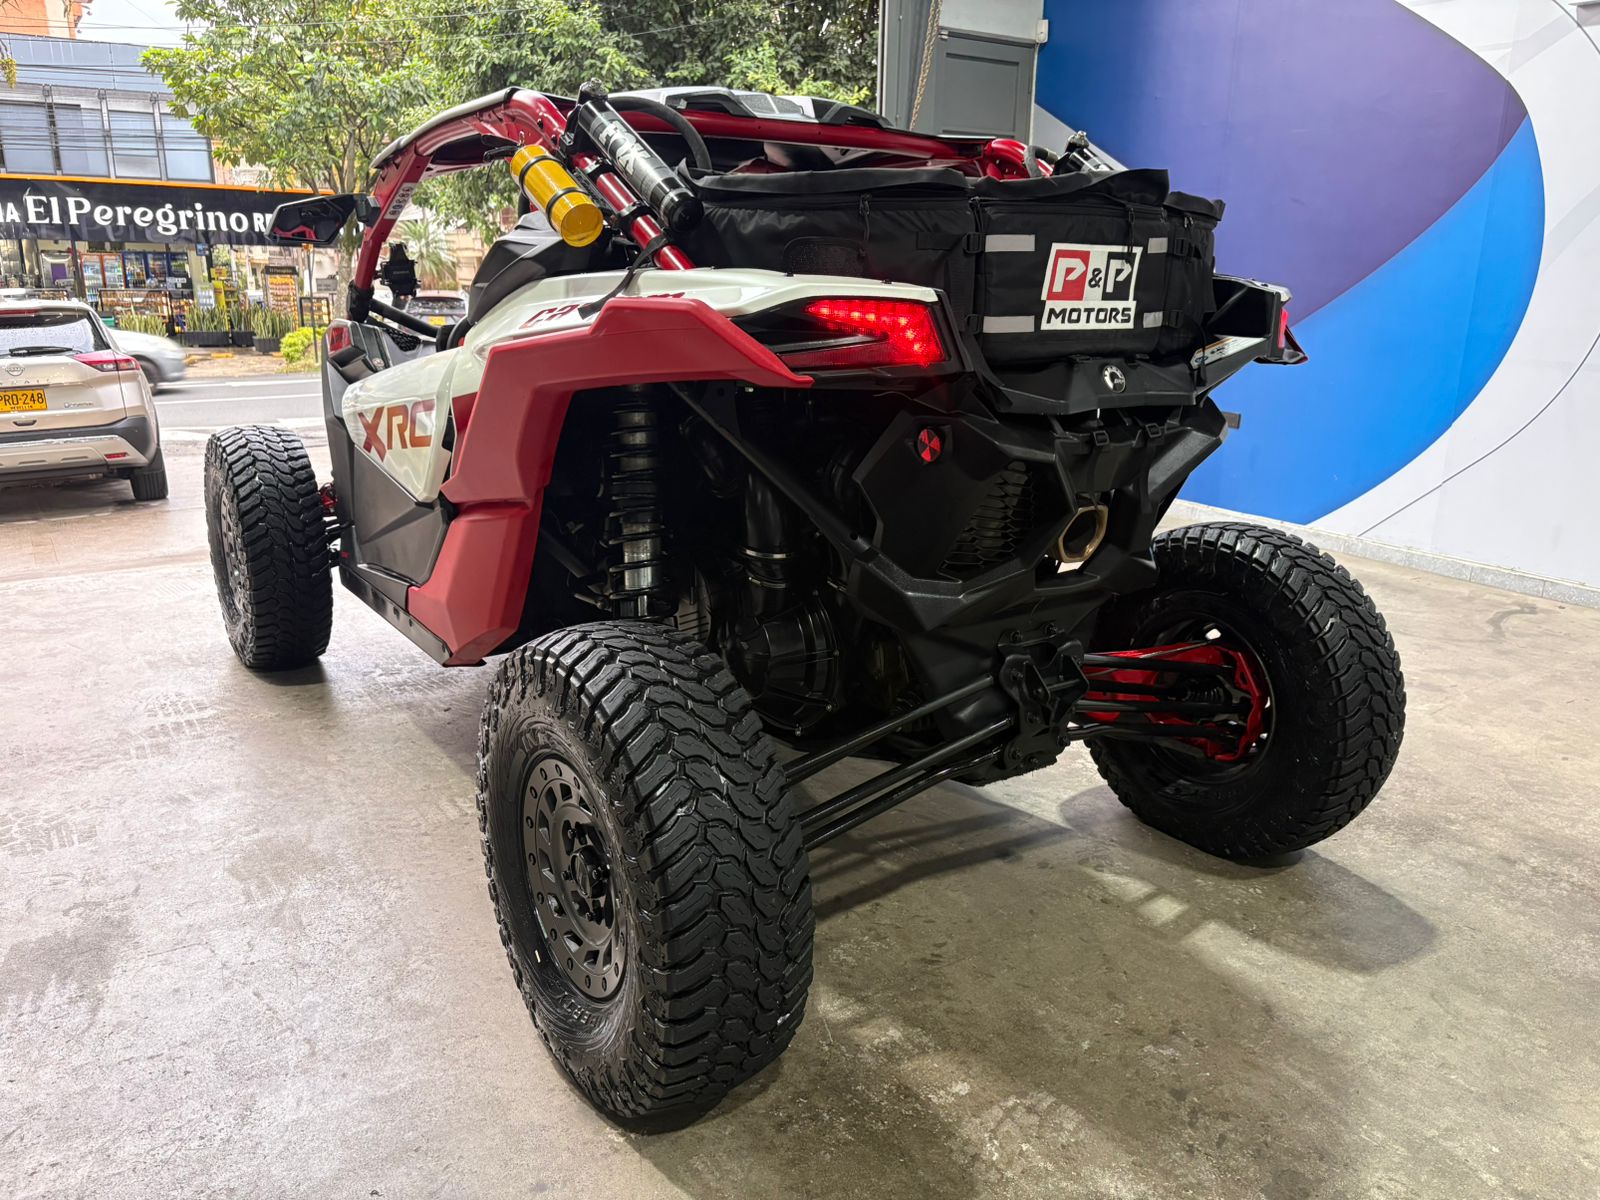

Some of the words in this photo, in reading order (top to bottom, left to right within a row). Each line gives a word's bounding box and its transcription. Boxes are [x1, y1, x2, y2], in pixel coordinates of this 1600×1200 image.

[598, 120, 651, 175] FOX
[26, 195, 62, 224] El
[66, 197, 249, 235] Peregrino
[253, 212, 273, 232] R
[1050, 256, 1133, 294] P&P
[1046, 307, 1132, 325] MOTORS
[358, 401, 436, 463] XRC
